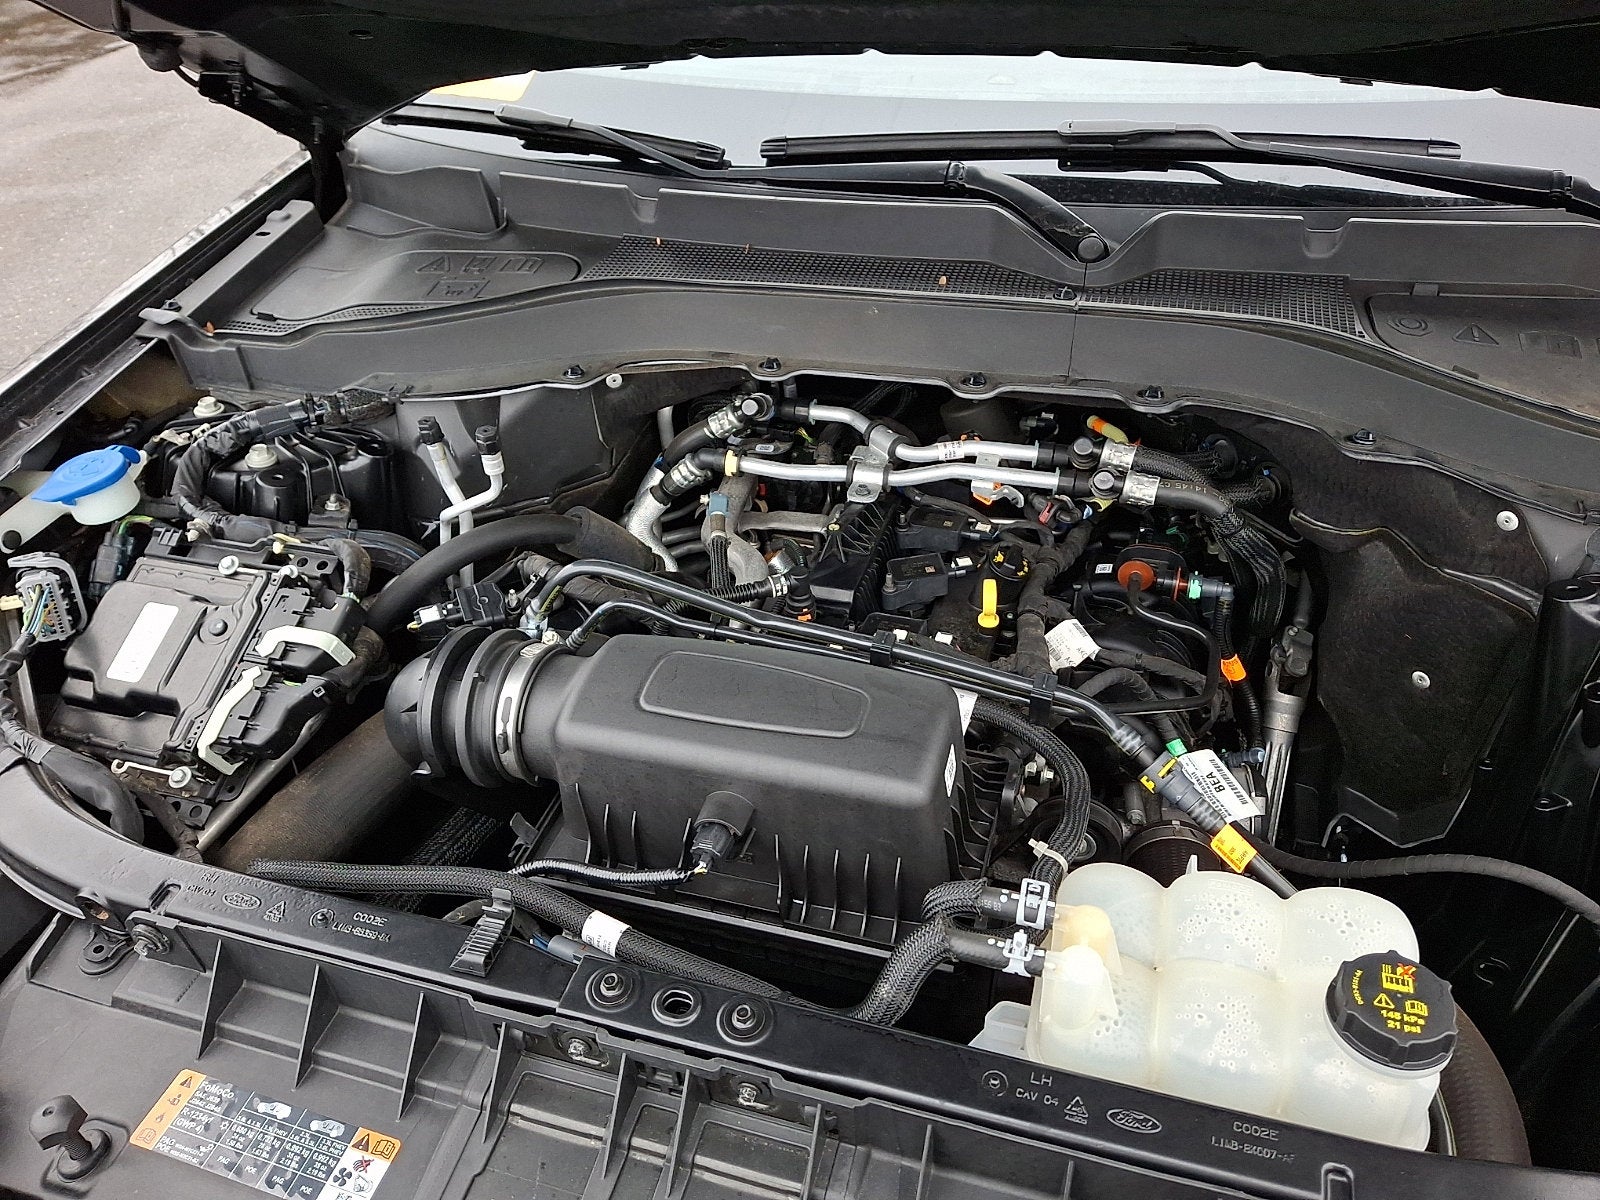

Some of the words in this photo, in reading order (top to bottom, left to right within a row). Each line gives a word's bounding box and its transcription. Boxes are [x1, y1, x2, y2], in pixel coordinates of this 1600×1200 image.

[1205, 771, 1226, 794] BEA
[1387, 1020, 1400, 1029] 21
[1404, 1025, 1421, 1033] psi
[1403, 1014, 1425, 1025] kPa
[1030, 1071, 1054, 1088] LH
[199, 1080, 236, 1099] FoMoCo
[299, 1185, 313, 1195] POE
